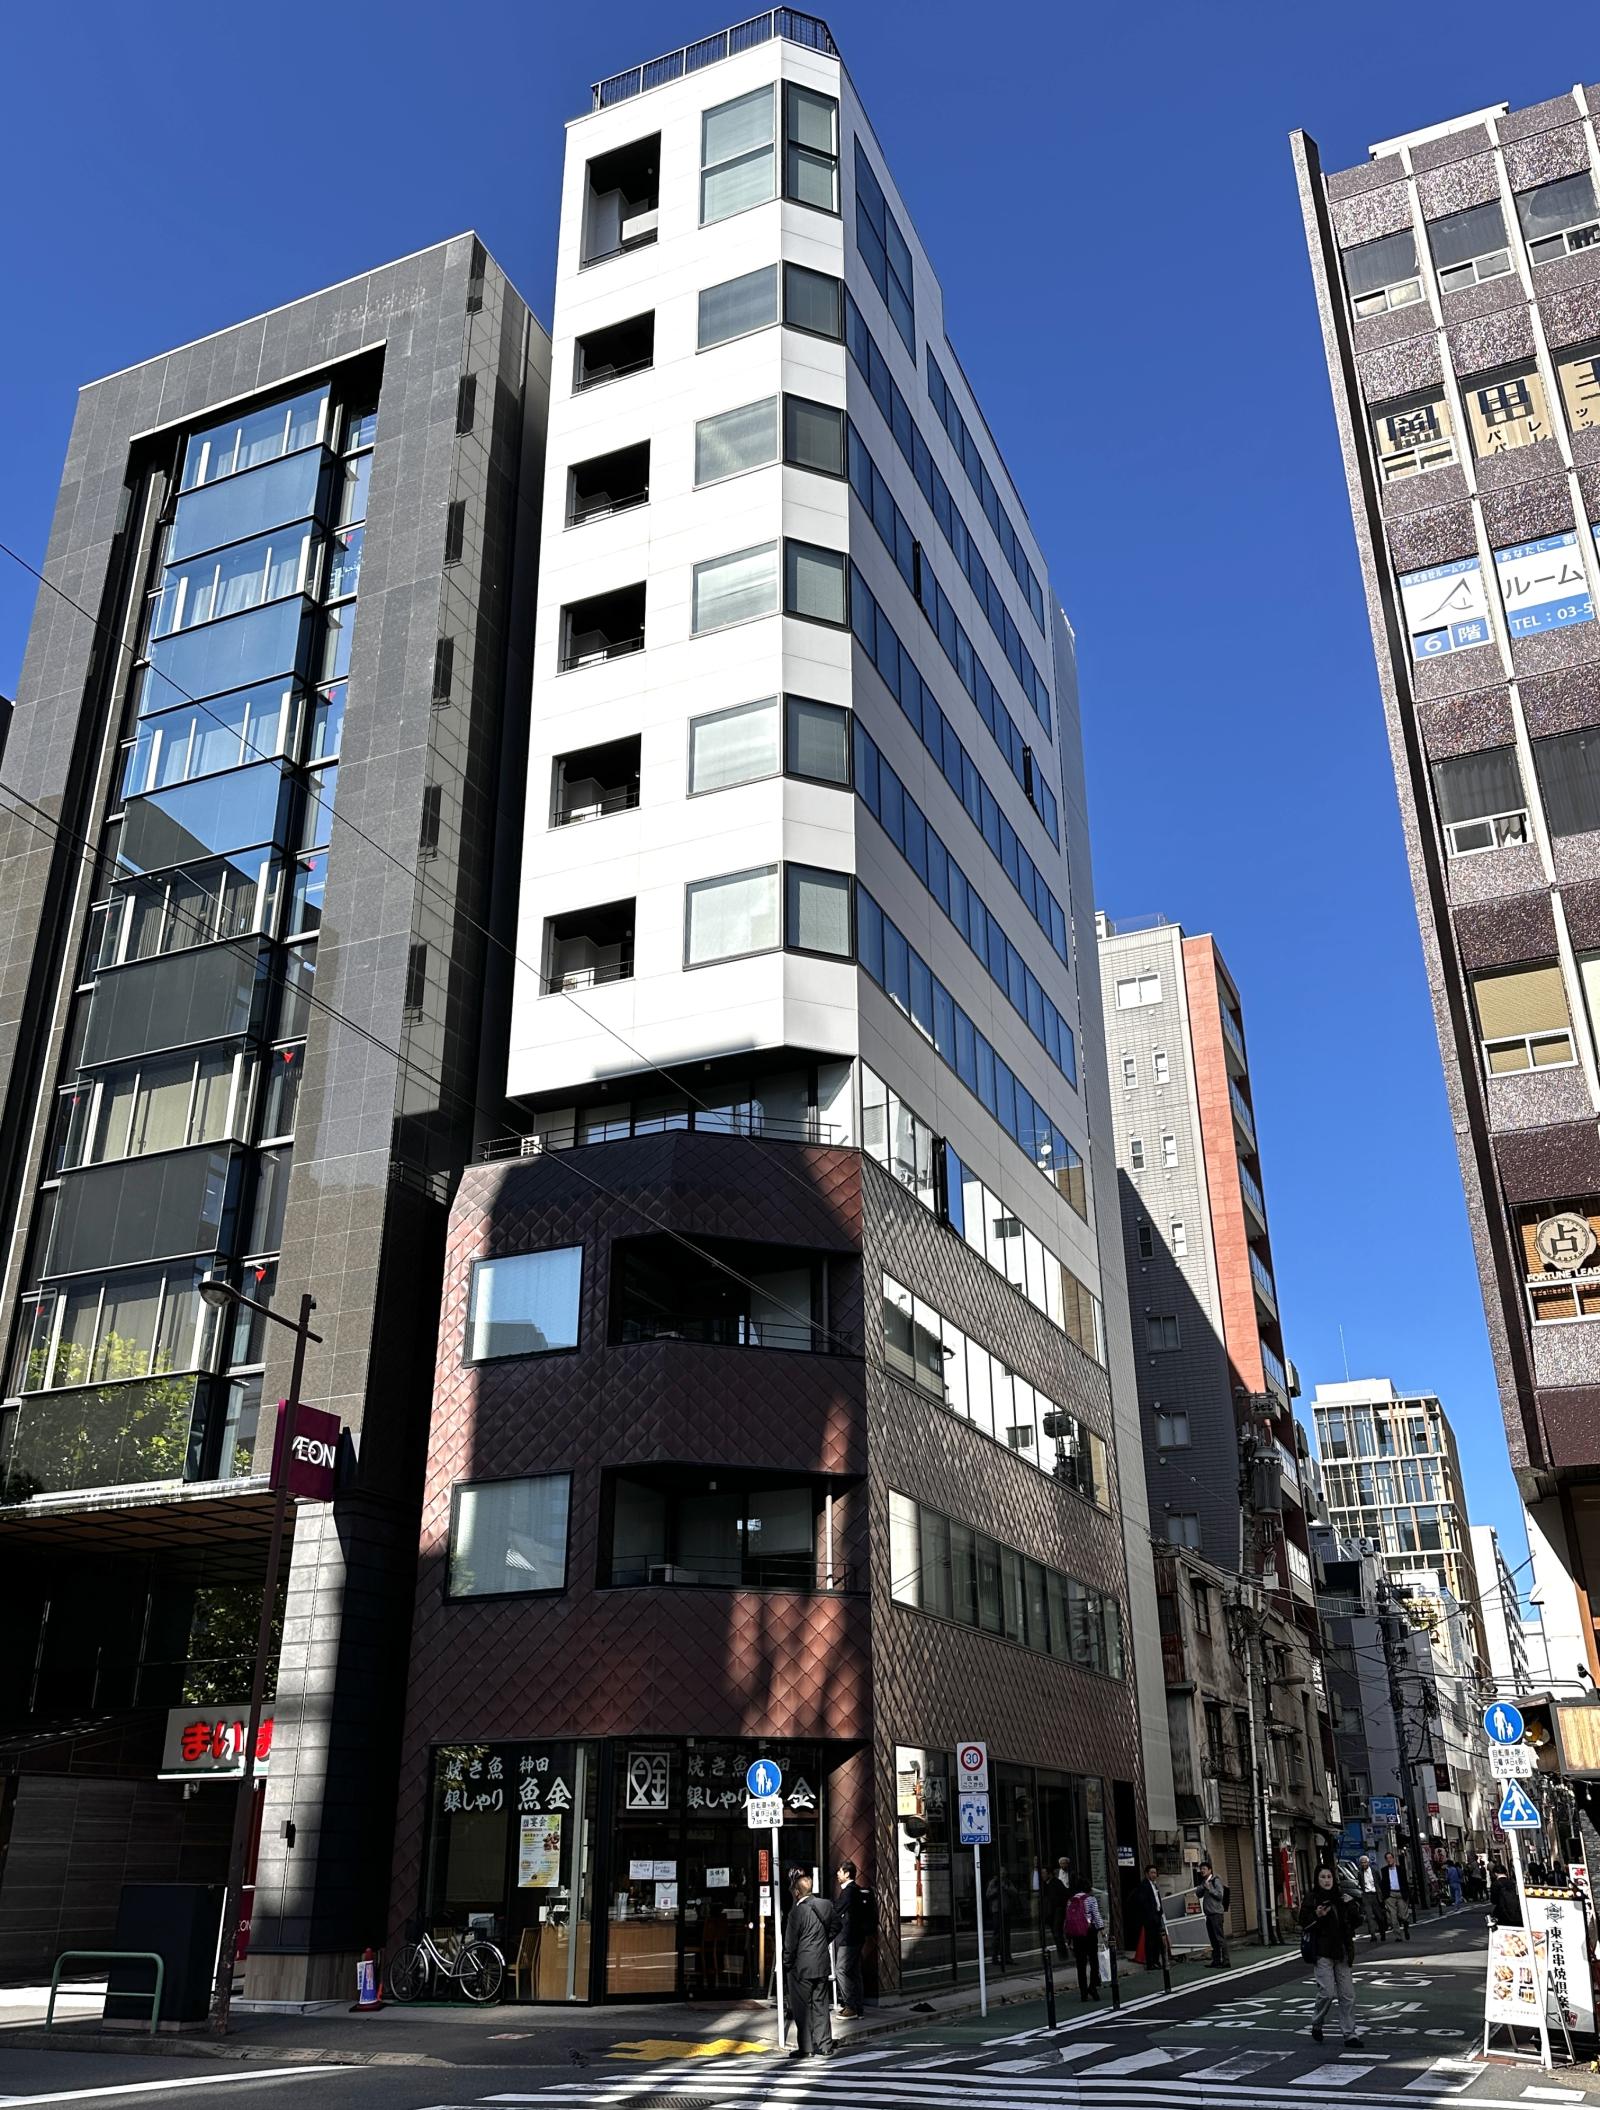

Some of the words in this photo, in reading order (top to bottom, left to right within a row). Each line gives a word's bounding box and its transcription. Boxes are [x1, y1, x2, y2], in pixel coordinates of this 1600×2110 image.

[1505, 564, 1584, 599] ルーム
[1550, 1223, 1579, 1256] 占
[1527, 1270, 1573, 1283] FORTUNE
[445, 1756, 504, 1781] 焼き魚
[519, 1755, 550, 1774] 神田
[965, 1753, 979, 1764] 30
[444, 1788, 503, 1812] 銀しゃり
[518, 1776, 572, 1811] 魚金
